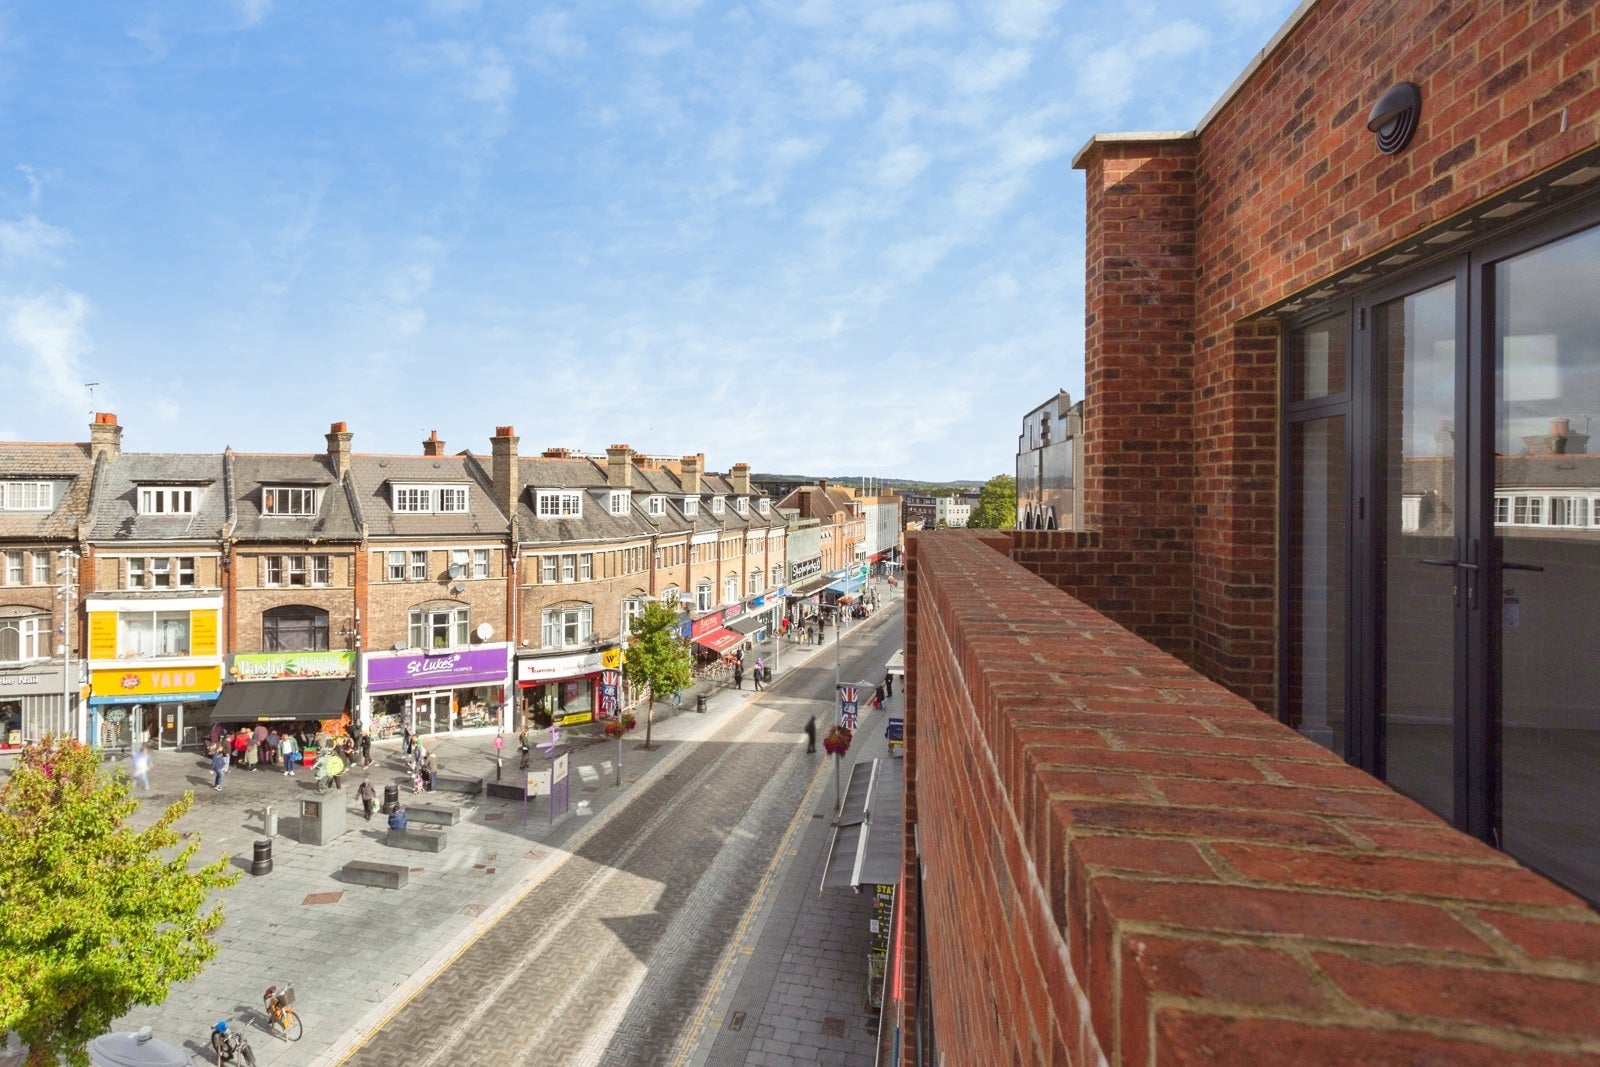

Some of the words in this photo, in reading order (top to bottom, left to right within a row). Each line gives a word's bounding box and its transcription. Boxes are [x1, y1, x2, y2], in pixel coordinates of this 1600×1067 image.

[240, 660, 284, 675] Pasha
[406, 661, 422, 674] St
[423, 656, 454, 672] Luke's
[18, 676, 38, 684] Nail
[151, 671, 196, 688] YAKO
